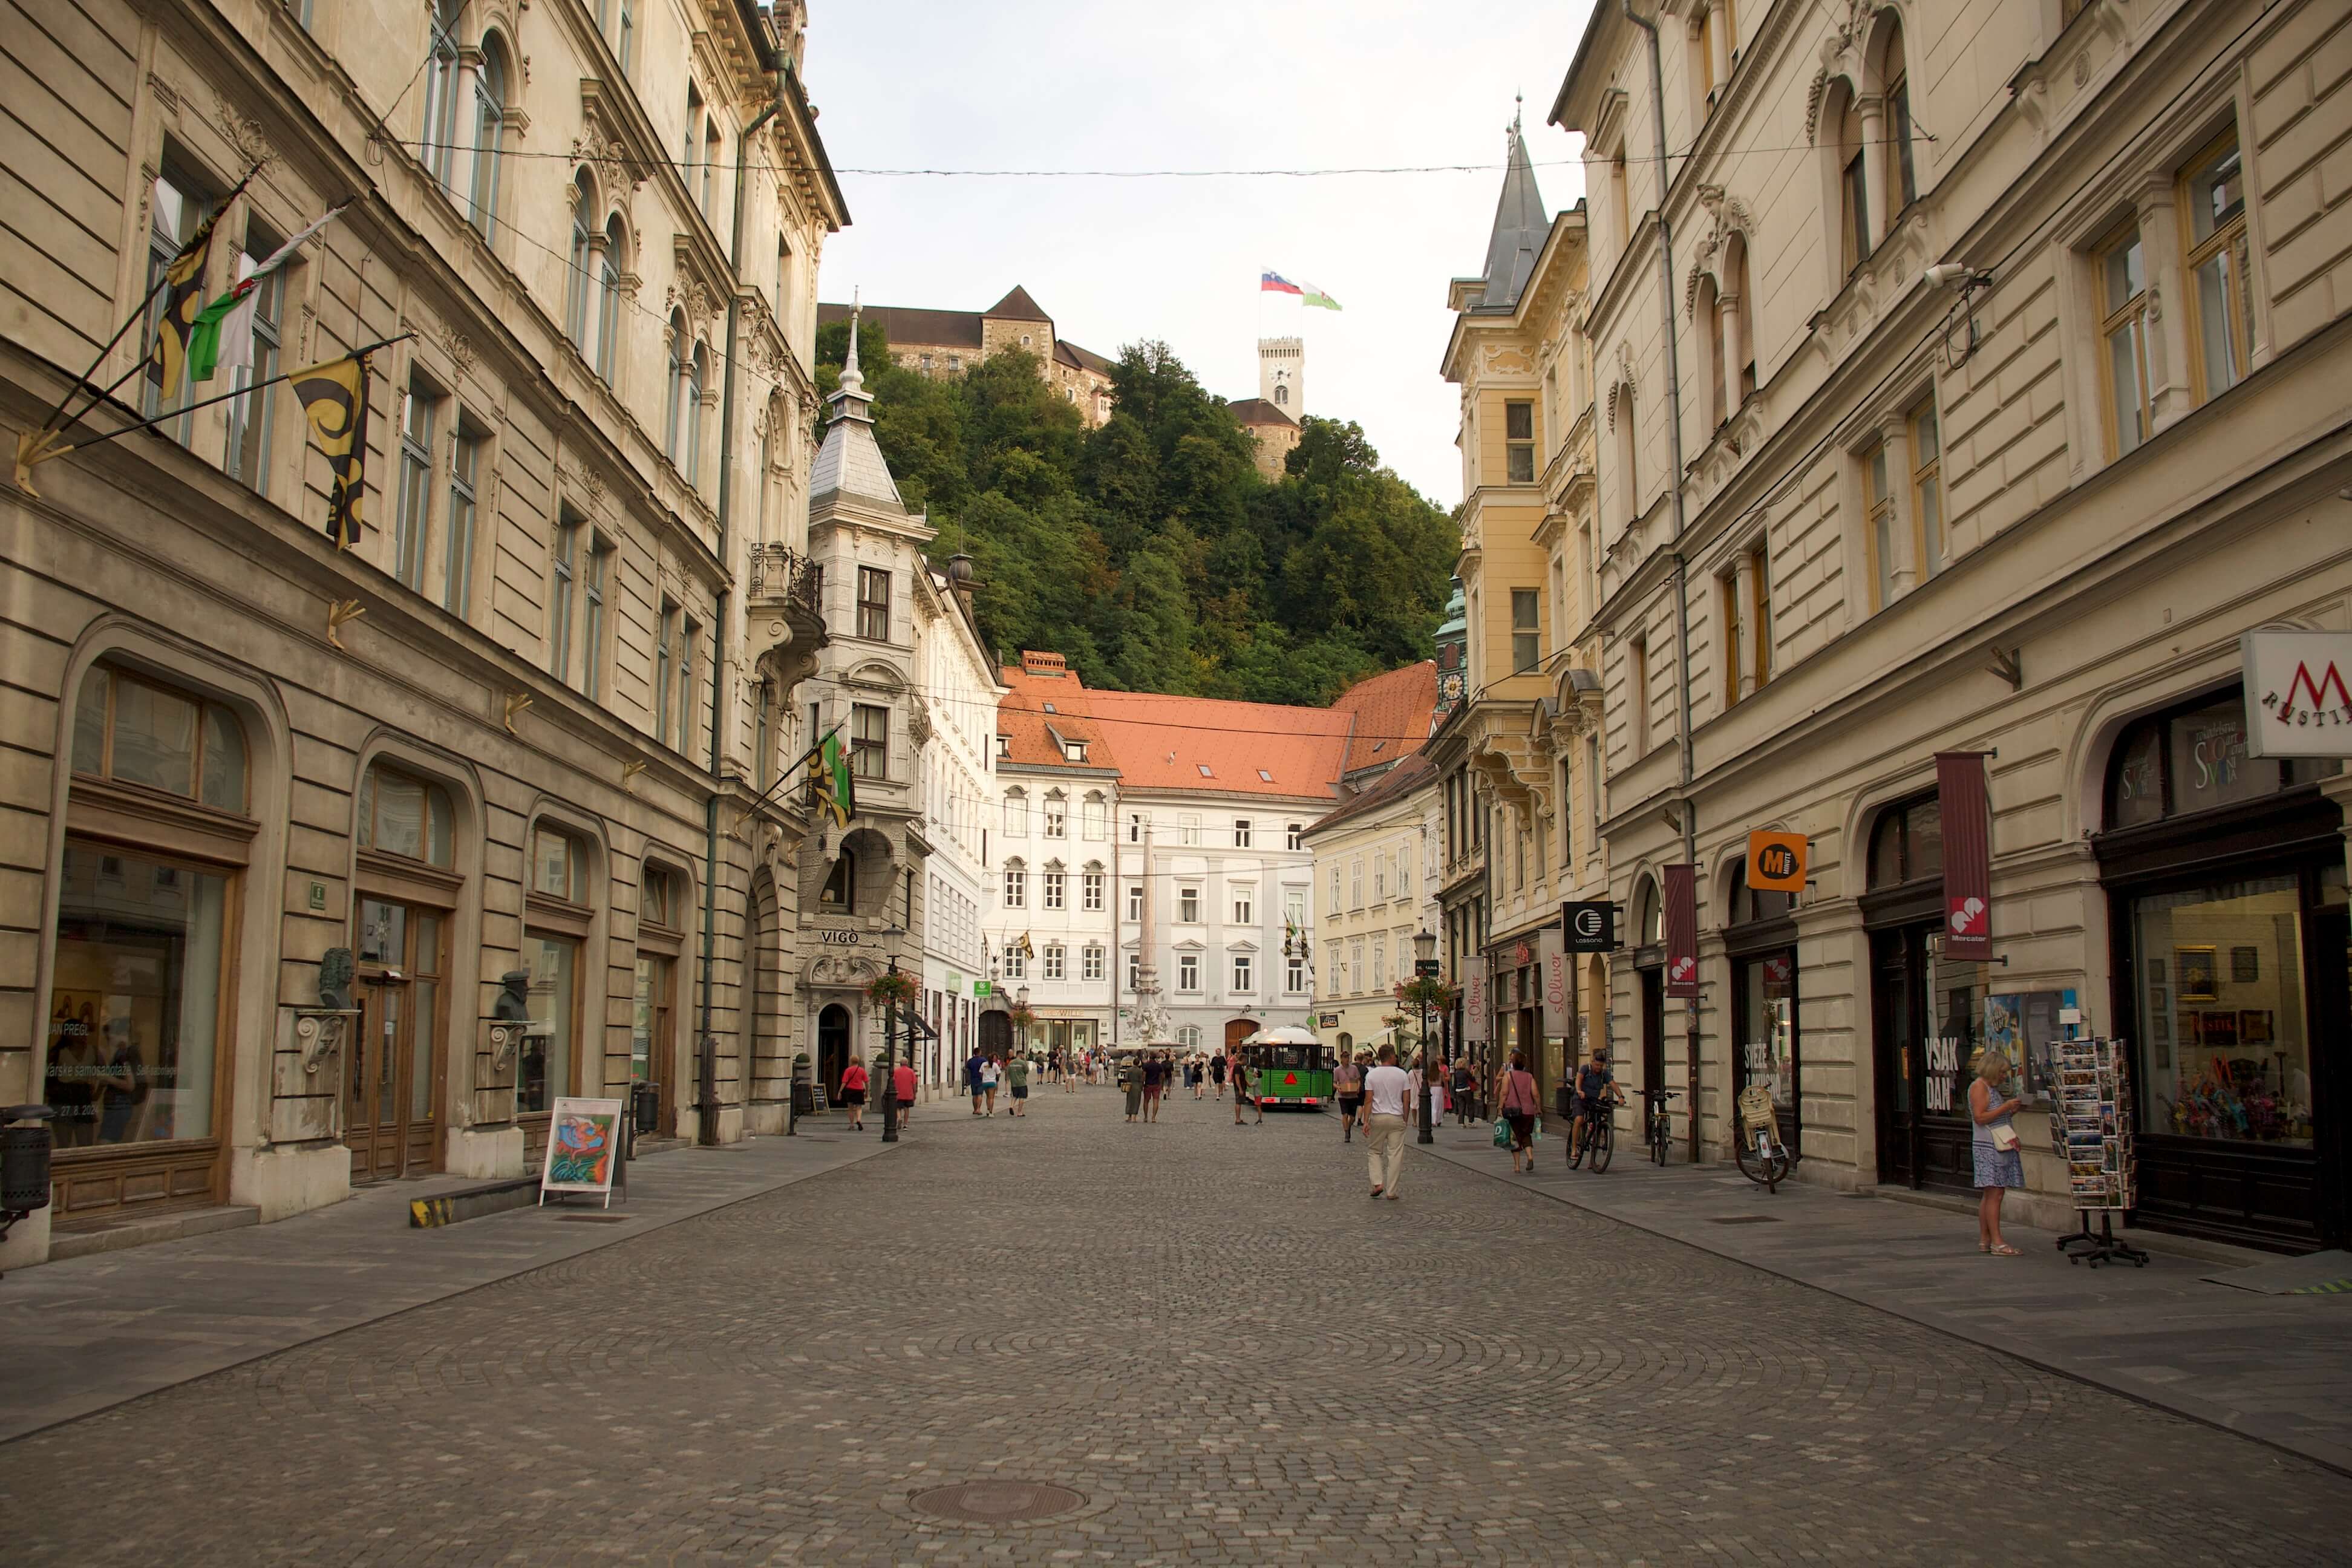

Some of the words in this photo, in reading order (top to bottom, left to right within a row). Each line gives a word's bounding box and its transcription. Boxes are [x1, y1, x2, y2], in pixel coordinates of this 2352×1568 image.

[1468, 975, 1481, 1024] s.Oliver
[1548, 952, 1564, 1014] s.Oliver
[64, 1023, 90, 1036] PREGL
[1745, 1037, 1768, 1069] SVEŽE
[1925, 1037, 1959, 1071] VSAK
[1926, 1076, 1950, 1111] DAN
